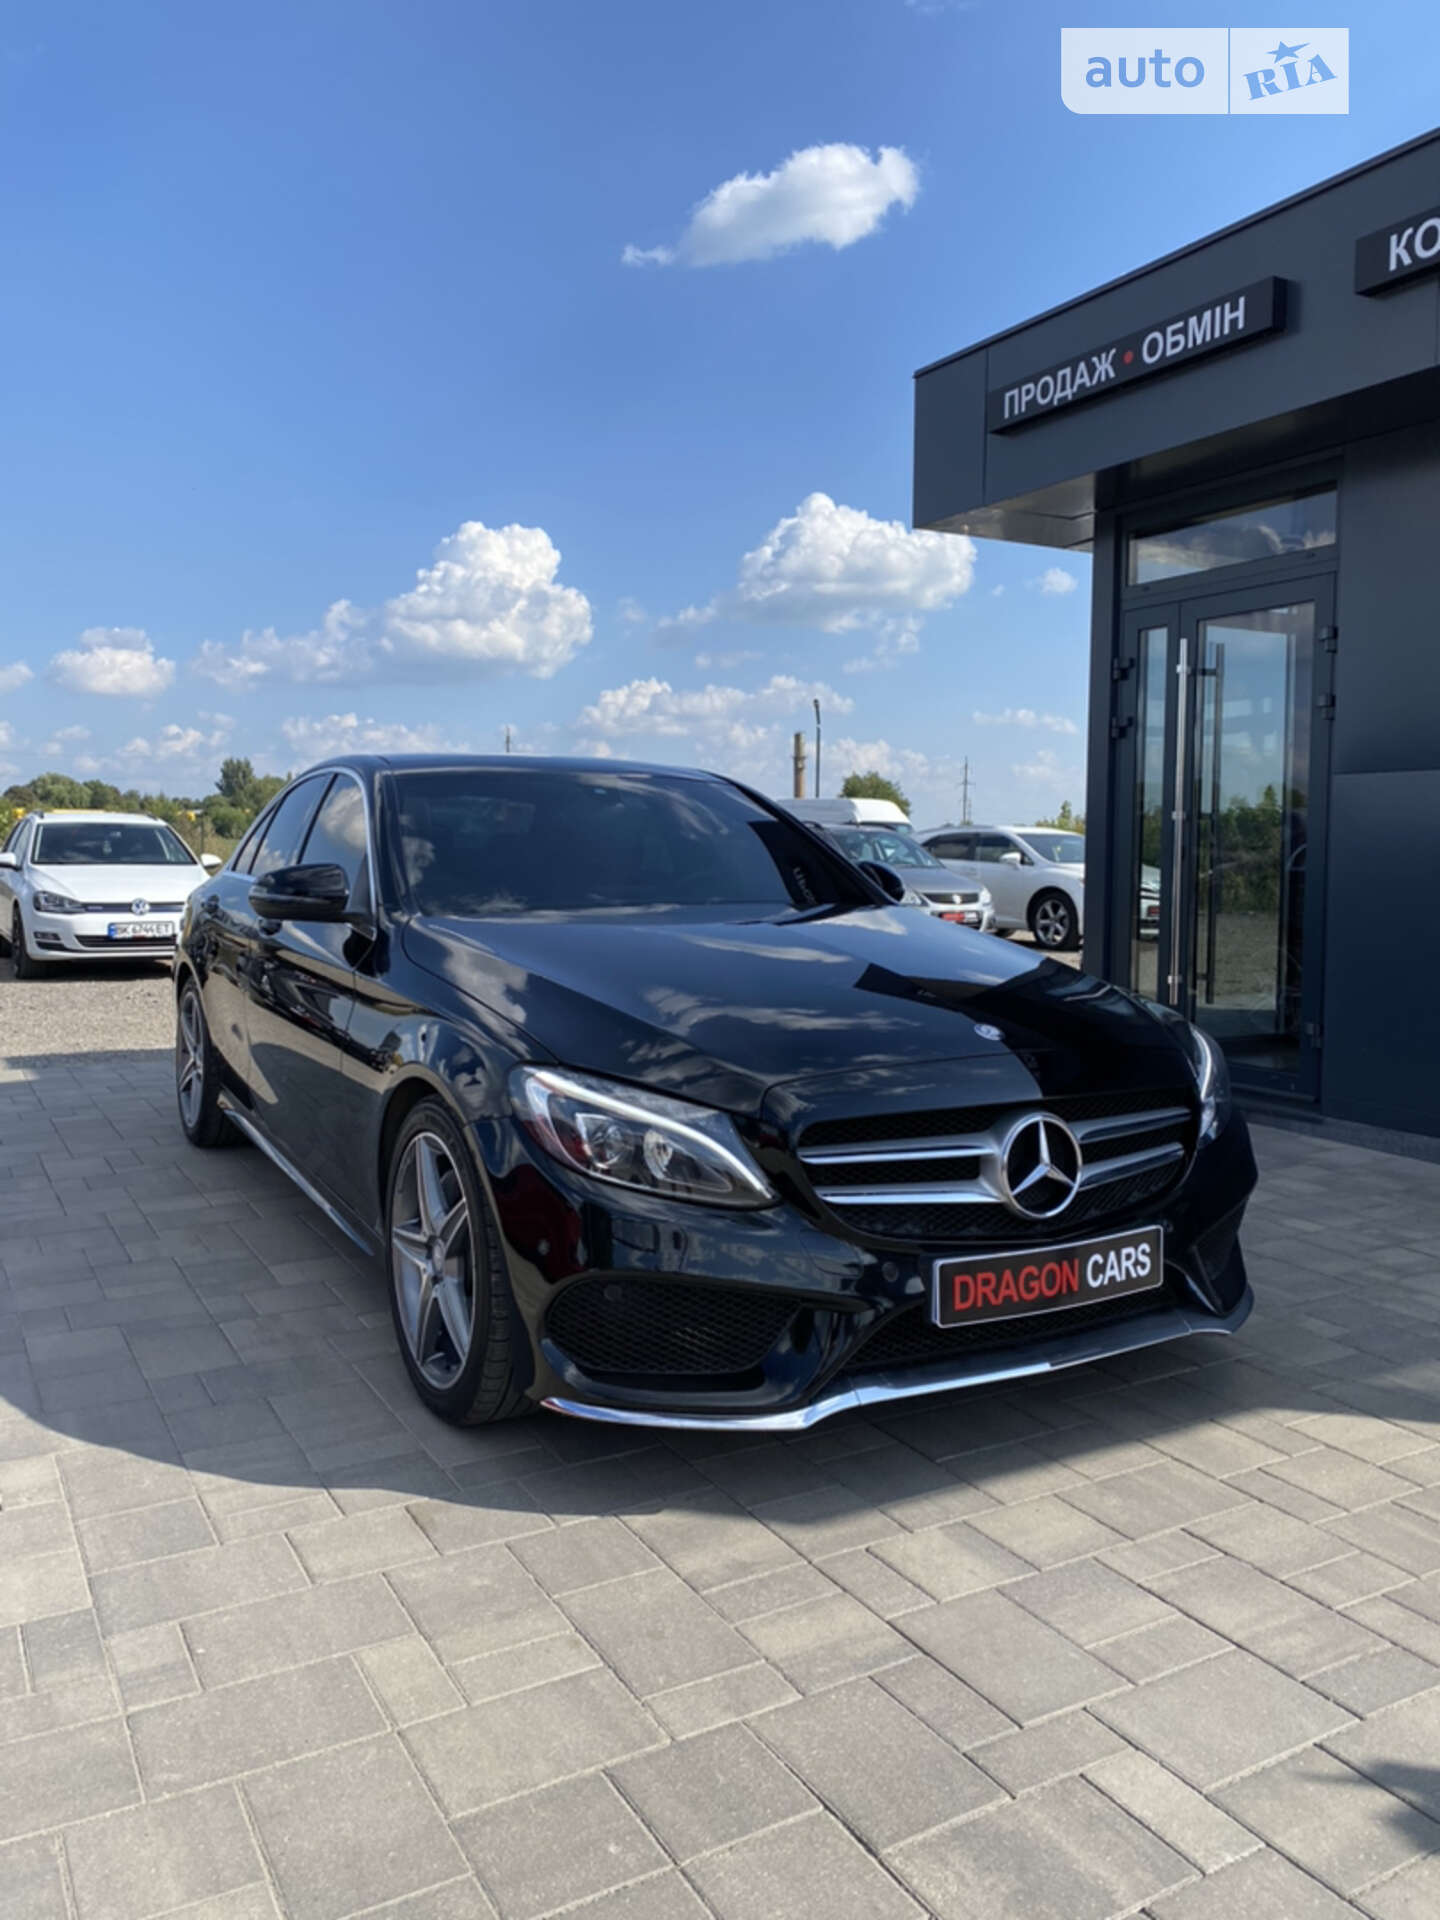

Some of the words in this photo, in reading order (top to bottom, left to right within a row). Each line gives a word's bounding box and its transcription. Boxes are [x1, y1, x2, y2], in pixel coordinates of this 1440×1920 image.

[1003, 347, 1116, 418] ПРОДАЖ
[1142, 296, 1246, 364] ОБМІН
[953, 1259, 1079, 1310] DRAGON
[1086, 1243, 1151, 1287] CARS
